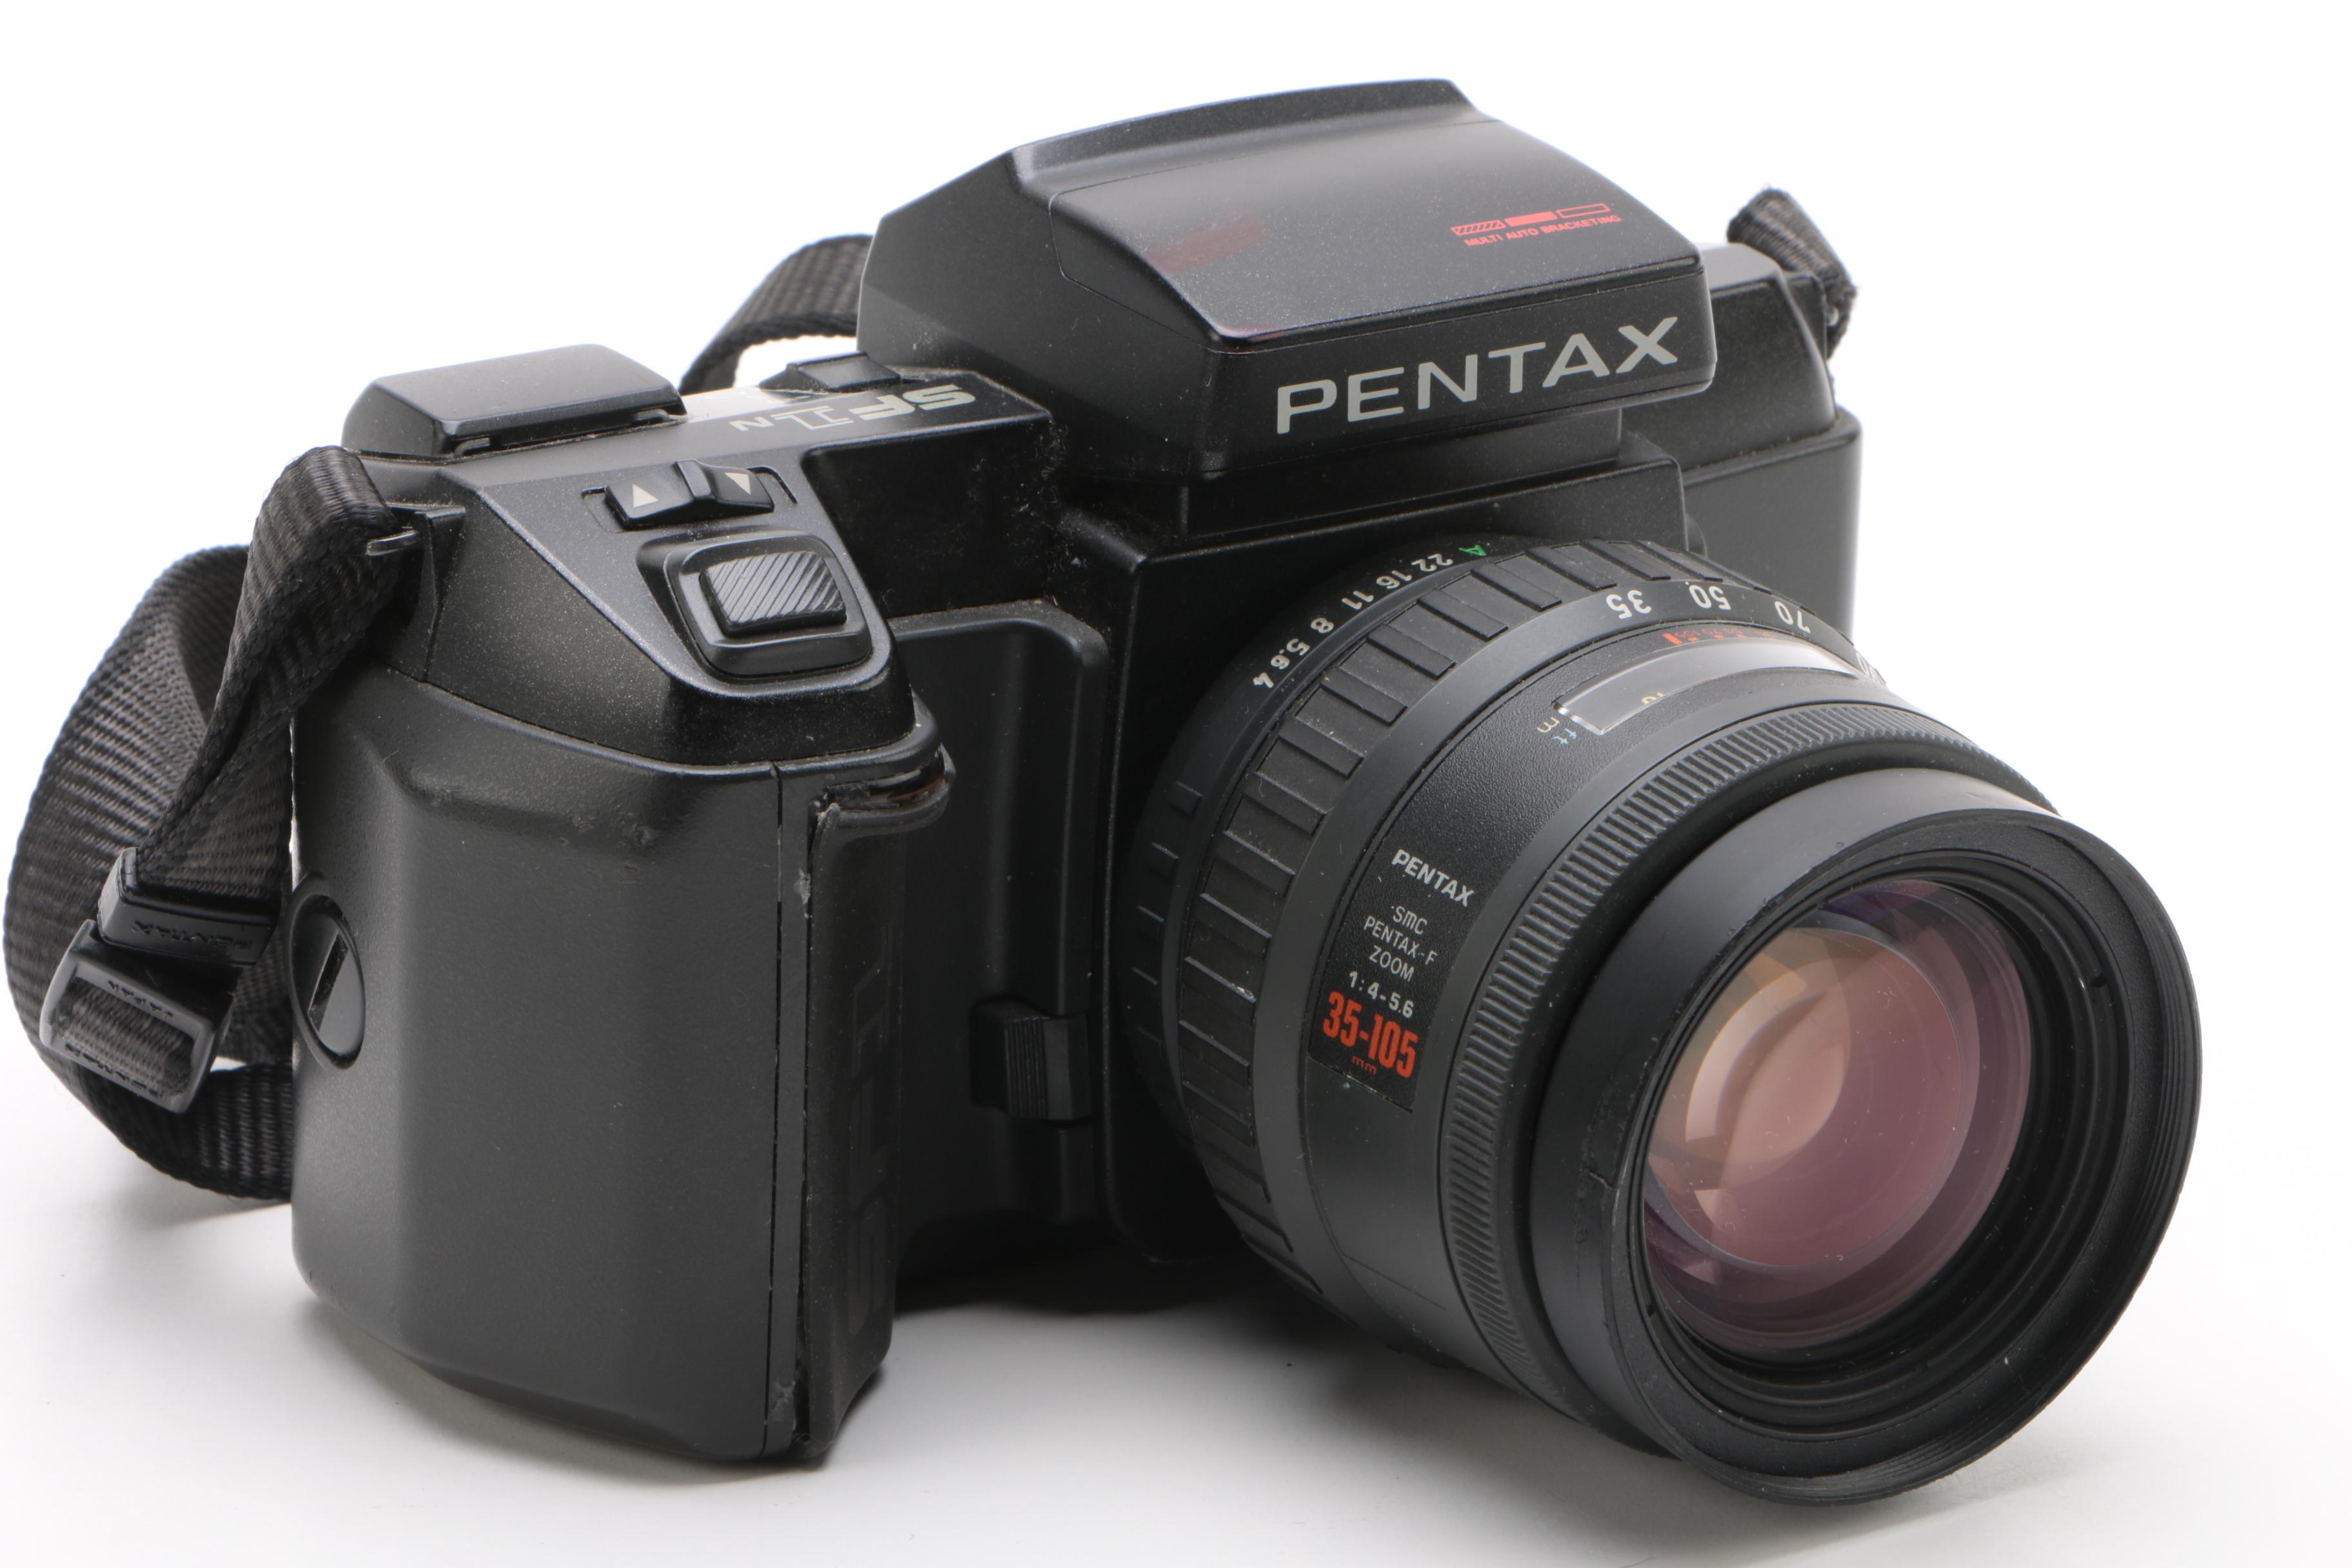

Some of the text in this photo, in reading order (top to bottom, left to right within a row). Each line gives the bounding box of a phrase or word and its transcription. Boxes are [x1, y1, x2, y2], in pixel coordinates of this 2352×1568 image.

[1464, 214, 1622, 247] MULTI AUTO BRACKETING
[1277, 316, 1678, 435] PENTAX
[1605, 590, 1652, 620] 35
[1689, 585, 1732, 611] 50
[1253, 545, 1487, 689] A 22 16 11 8 5.6 4
[1774, 601, 1811, 634] 70
[1536, 716, 1560, 733] m
[1552, 727, 1578, 745] ft
[1391, 848, 1475, 907] PENTAX
[1369, 945, 1415, 983] ZOOM
[1323, 991, 1419, 1079] 35-105
[1352, 1055, 1378, 1075] mm
